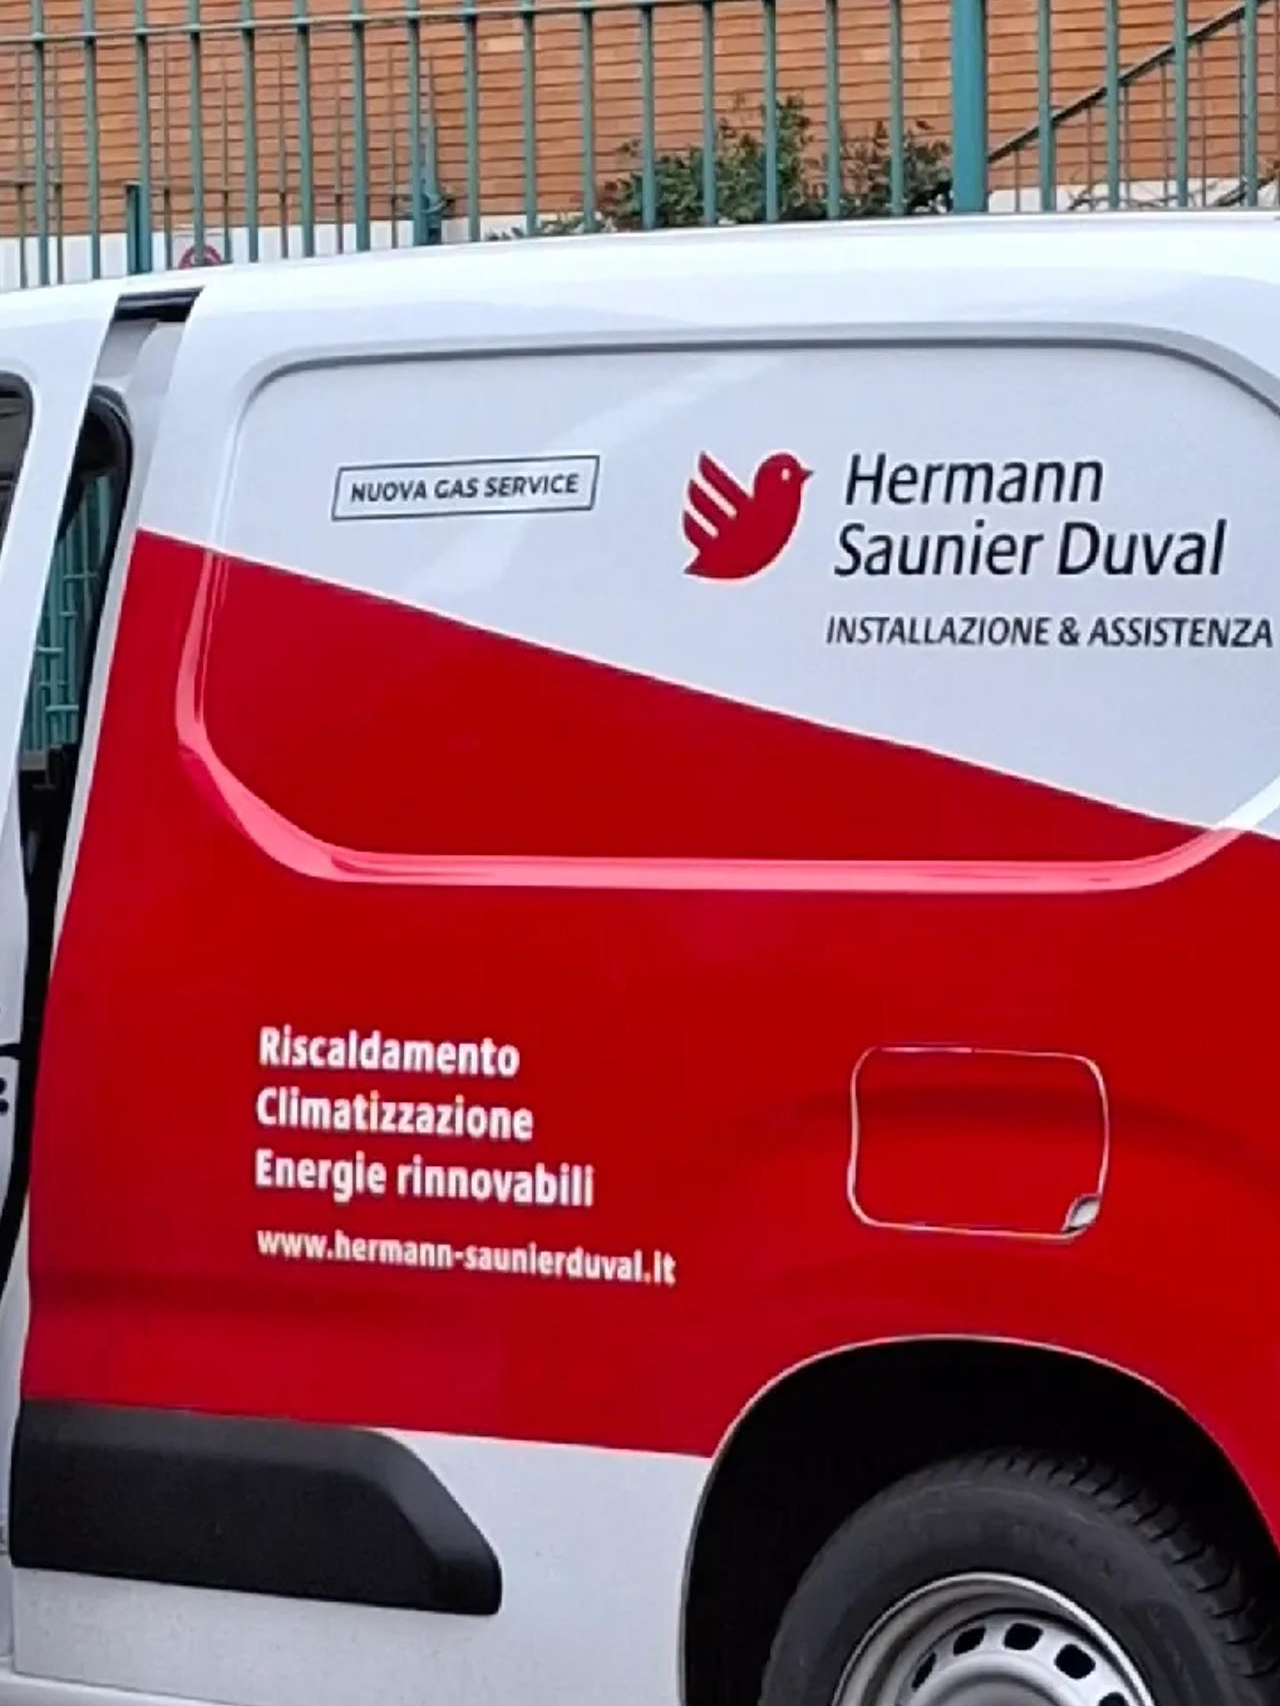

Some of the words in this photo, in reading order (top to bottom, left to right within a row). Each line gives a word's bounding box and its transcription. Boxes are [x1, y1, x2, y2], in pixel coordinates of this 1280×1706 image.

[350, 480, 428, 503] NUOVA
[434, 477, 479, 499] GAS
[483, 472, 580, 498] SERVICE
[844, 452, 1104, 506] Hermann
[833, 518, 1045, 577] Saunier
[1056, 517, 1228, 576] Duval
[825, 615, 1052, 646] INSTALLAZIONE
[1058, 618, 1081, 646] &
[1086, 617, 1275, 648] ASSISTENZA
[258, 1024, 521, 1078] Riscaldamento
[254, 1086, 535, 1142] Climatizzazione
[254, 1148, 387, 1205] Energie
[397, 1154, 595, 1207] rinnovabili
[256, 1229, 678, 1286] www.hermann-saunierduval.it
